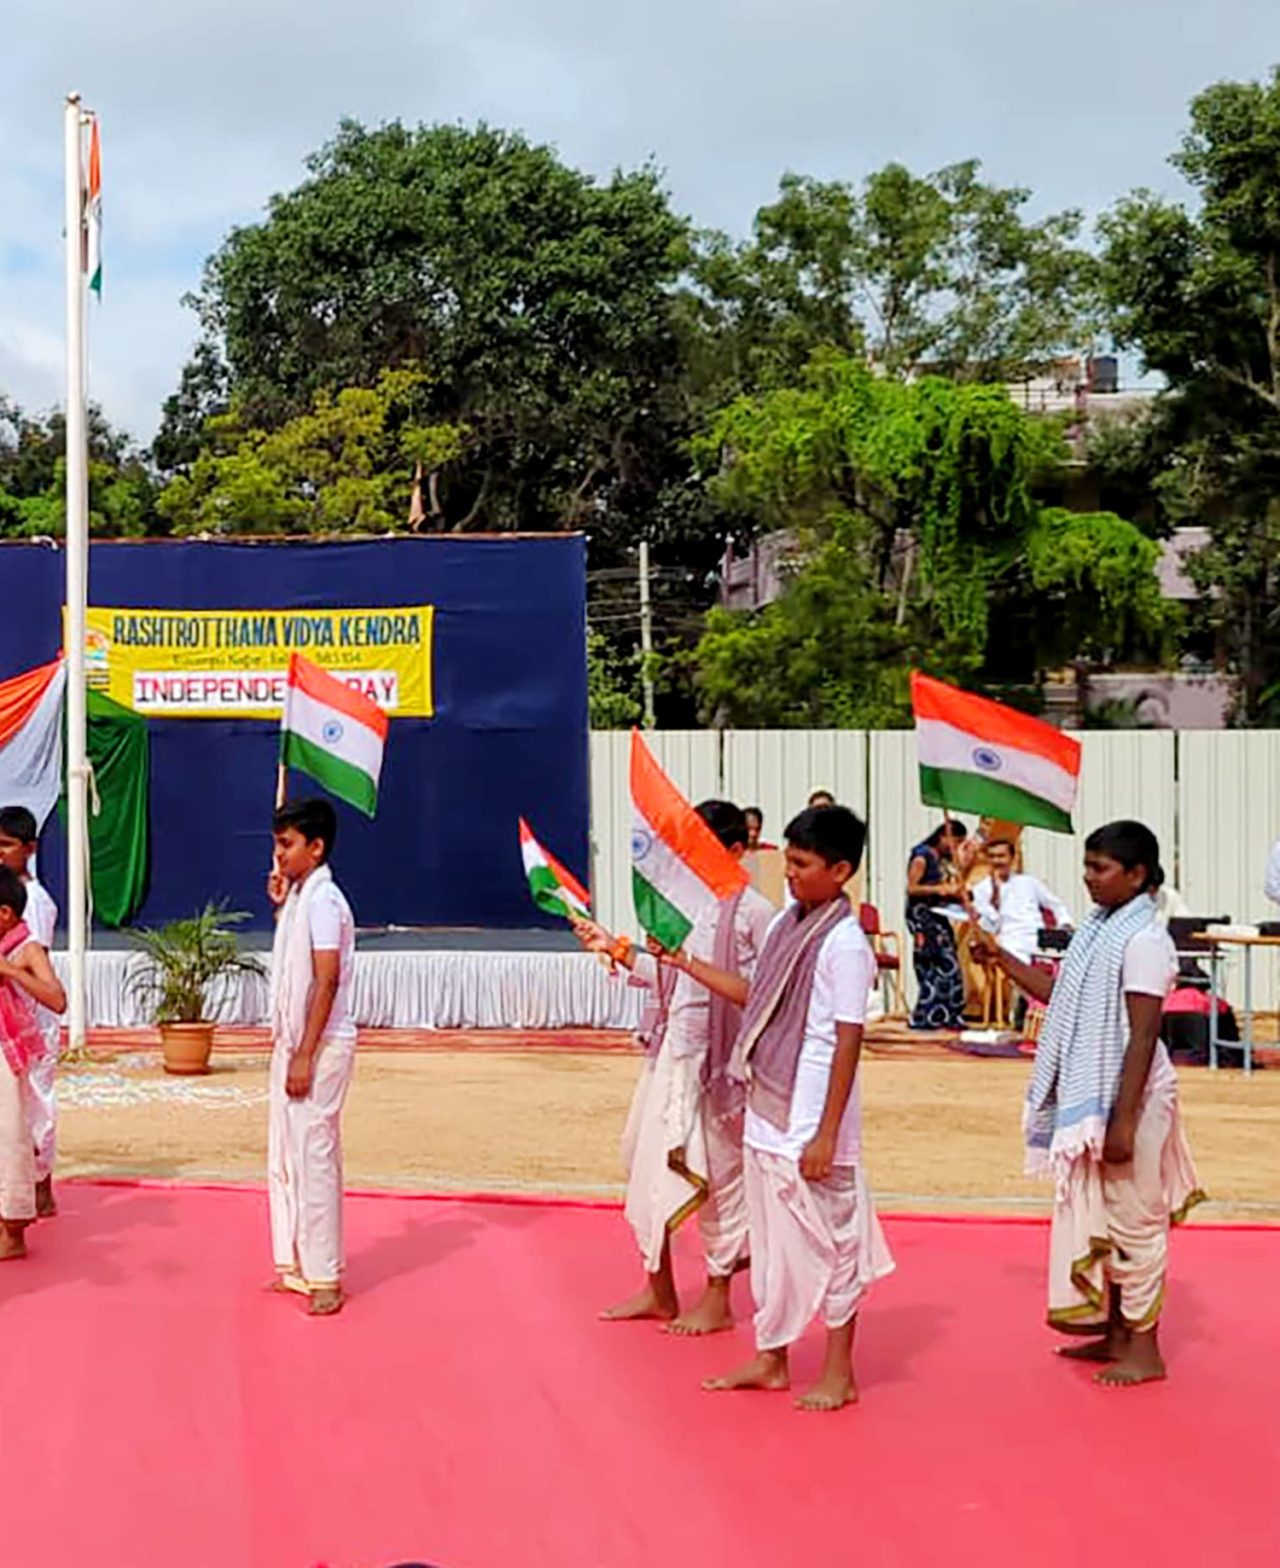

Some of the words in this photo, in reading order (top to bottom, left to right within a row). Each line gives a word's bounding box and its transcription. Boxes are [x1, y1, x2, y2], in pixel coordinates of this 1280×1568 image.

[281, 616, 334, 647] VIDYA
[339, 613, 420, 646] KENDRA
[136, 677, 286, 703] INDEPENDE
